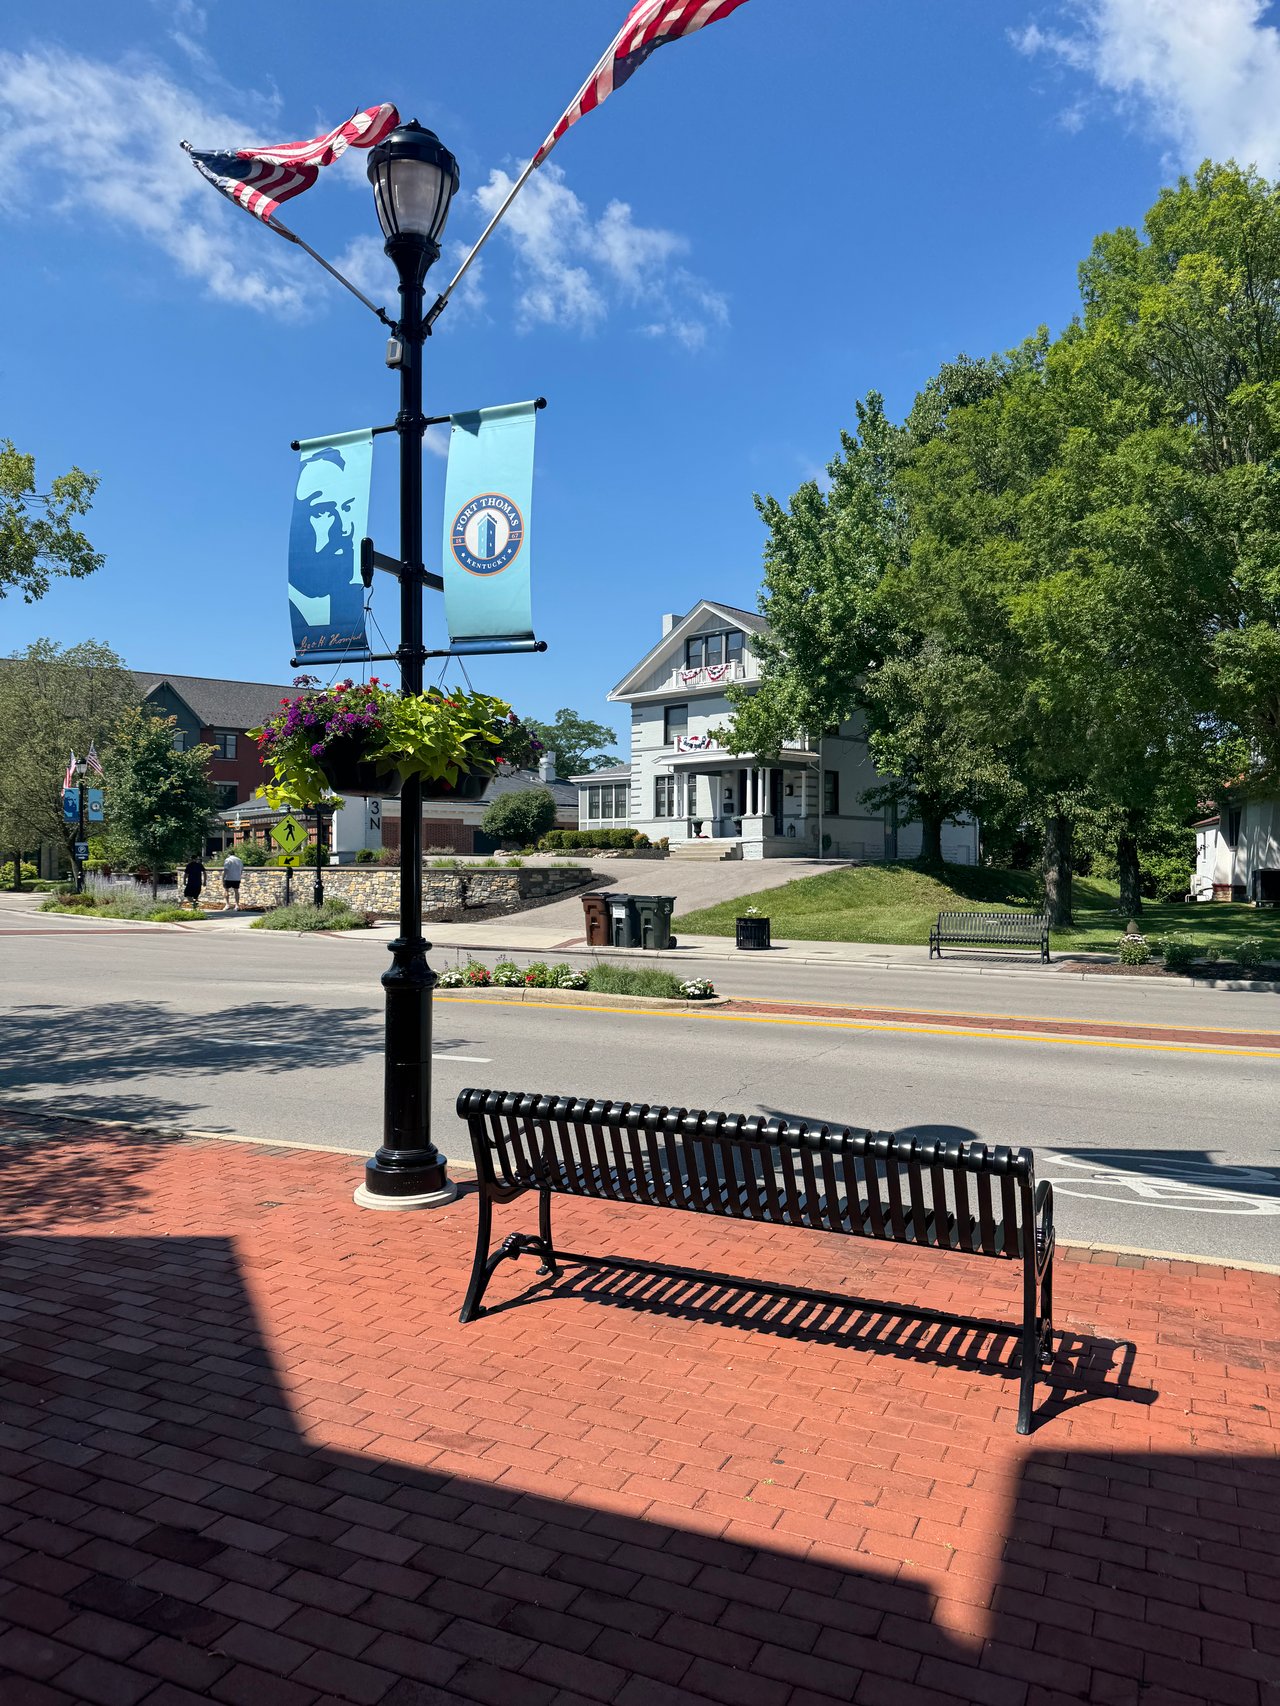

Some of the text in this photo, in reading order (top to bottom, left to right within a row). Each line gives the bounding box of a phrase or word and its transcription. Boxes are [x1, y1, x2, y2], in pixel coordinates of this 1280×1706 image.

[456, 497, 519, 531] FORT THOMAS
[466, 555, 507, 569] KENTUCKY
